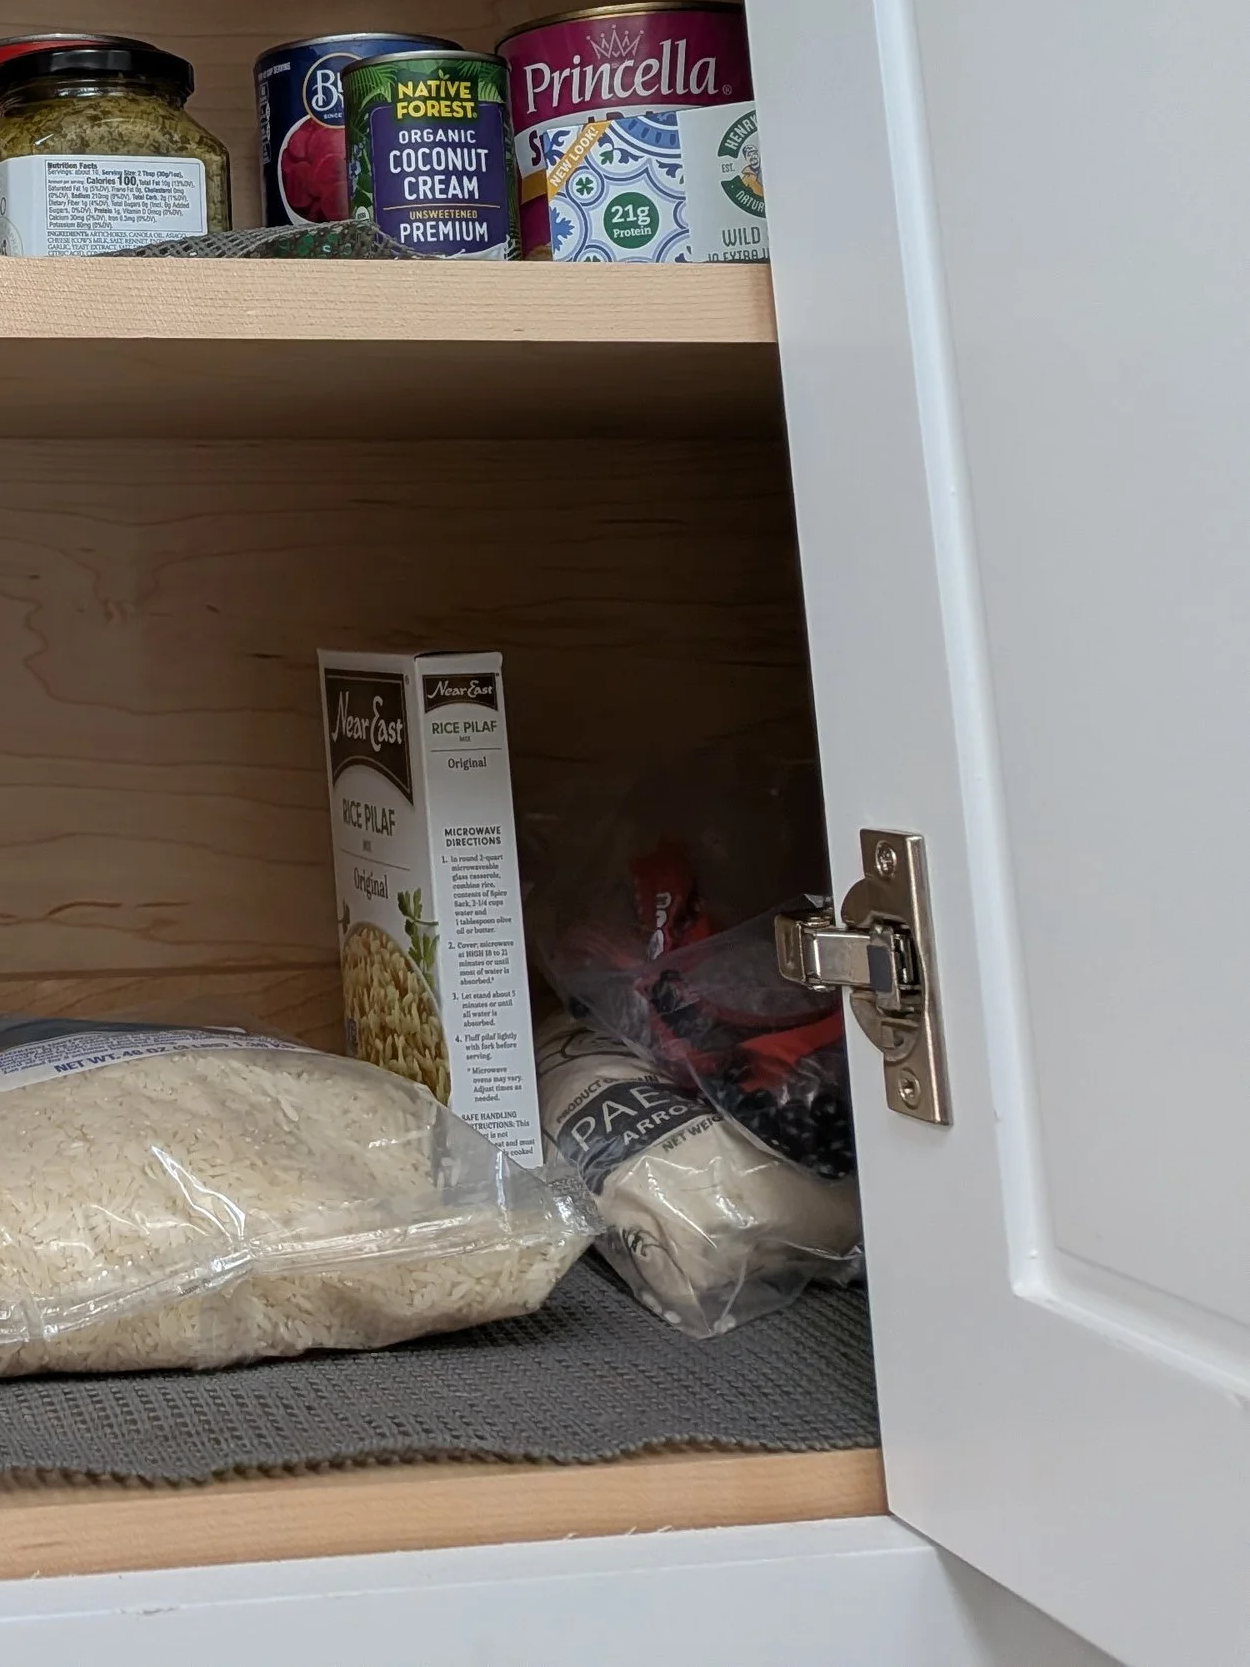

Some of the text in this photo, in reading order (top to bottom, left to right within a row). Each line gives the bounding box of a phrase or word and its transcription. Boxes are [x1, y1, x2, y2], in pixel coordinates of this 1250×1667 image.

[524, 38, 719, 115] Princella
[397, 80, 472, 99] NATIVE
[396, 100, 476, 119] FOREST
[399, 129, 476, 144] ORGANIC
[389, 147, 489, 173] COCONUT
[550, 126, 599, 187] NEW LOOK!
[79, 162, 98, 170] Facts
[722, 163, 735, 173] EST.
[86, 177, 116, 185] Calories
[404, 175, 479, 200] CREAM
[409, 209, 478, 220] UNSWEETENED
[611, 204, 650, 226] 21g
[400, 221, 489, 243] PREMIUM
[613, 226, 652, 239] Protein
[722, 227, 761, 247] WILD
[428, 679, 493, 699] Near East
[332, 691, 403, 752] Near East
[431, 720, 497, 734] RICE PILAF
[448, 756, 487, 771] Original
[342, 798, 396, 837] RICE PILAF
[444, 825, 502, 837] MICROWAVE
[445, 836, 502, 848] DIRECTIONS
[459, 854, 478, 862] round
[353, 866, 389, 901] Original
[460, 917, 495, 926] tablespoon
[452, 992, 459, 1000] 3.
[473, 991, 491, 999] stand
[492, 990, 511, 998] about
[481, 1042, 494, 1050] fork
[53, 1060, 86, 1073] NET
[89, 1052, 121, 1066] WT.
[474, 1085, 494, 1094] Adjust
[481, 1111, 517, 1120] HANDLING
